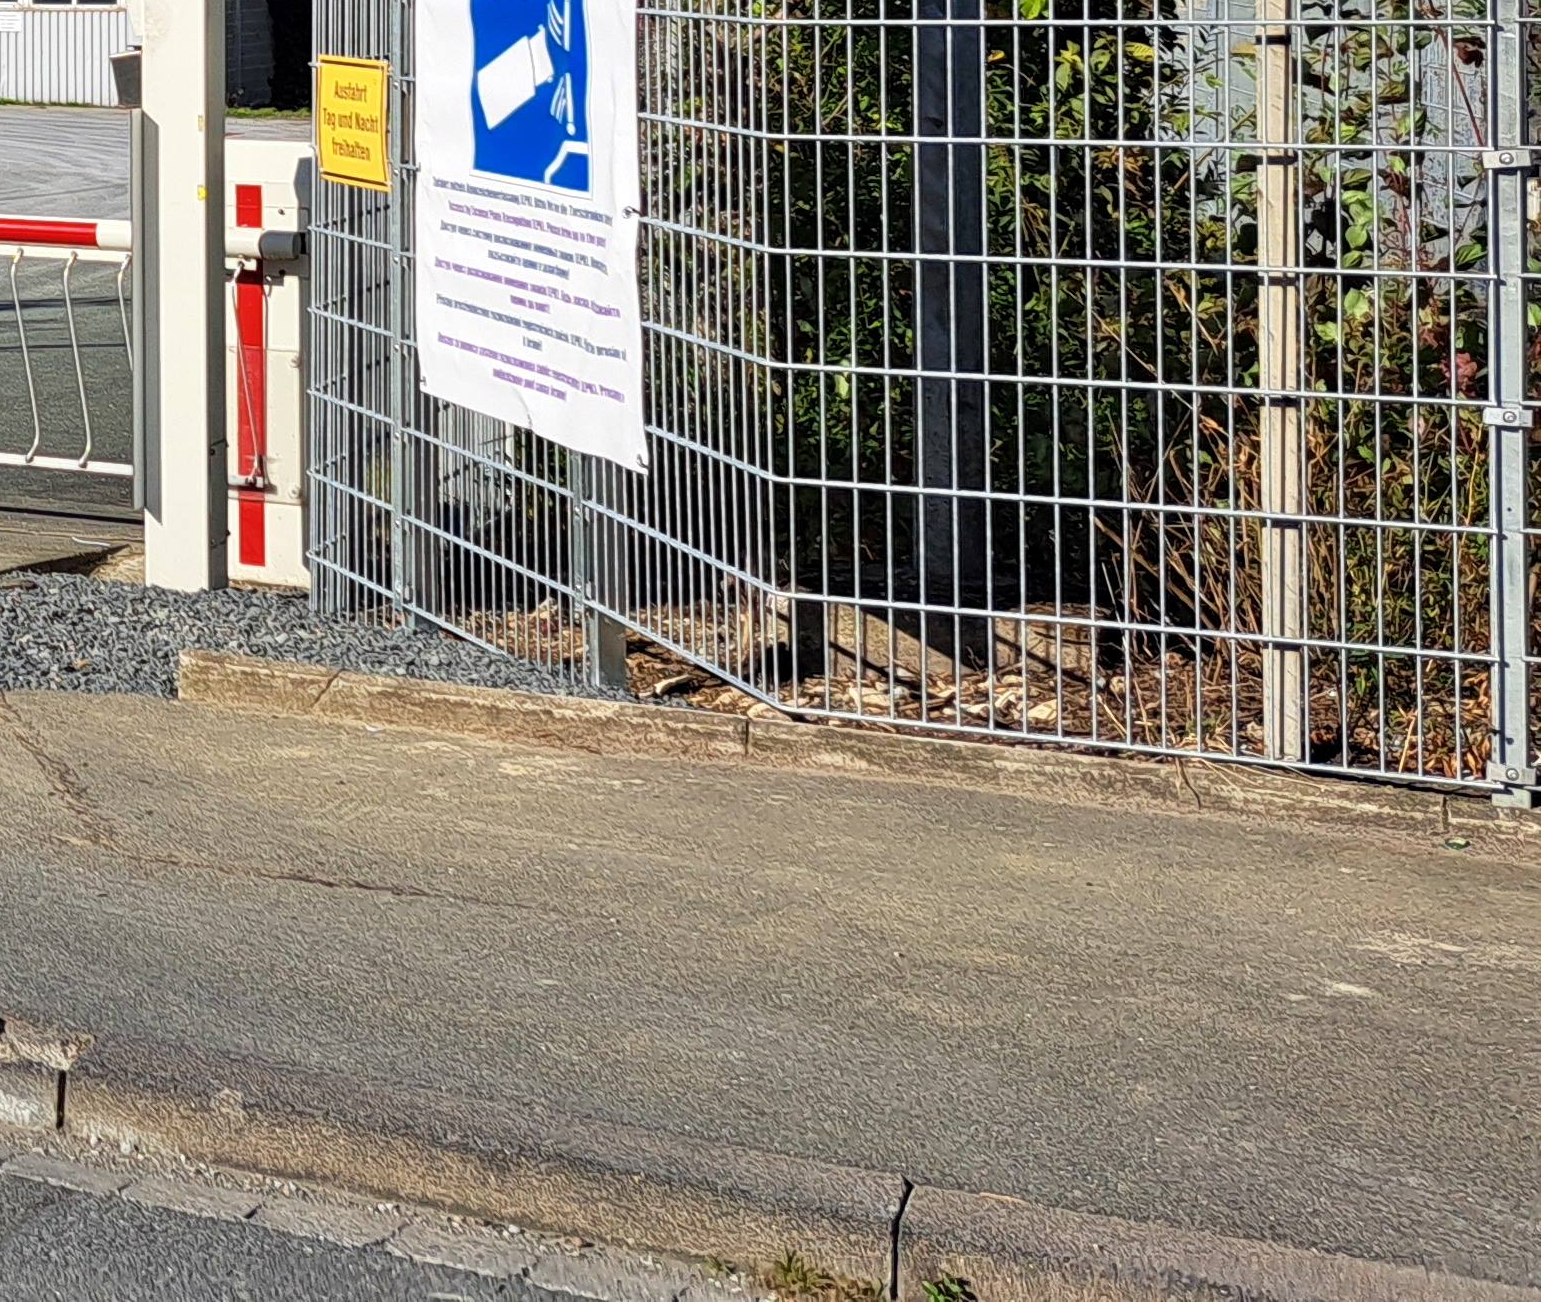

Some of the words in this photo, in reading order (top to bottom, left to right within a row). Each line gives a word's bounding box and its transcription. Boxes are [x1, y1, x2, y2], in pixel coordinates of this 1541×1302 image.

[323, 108, 336, 131] Tag
[338, 111, 353, 129] und
[355, 112, 379, 133] Nacht
